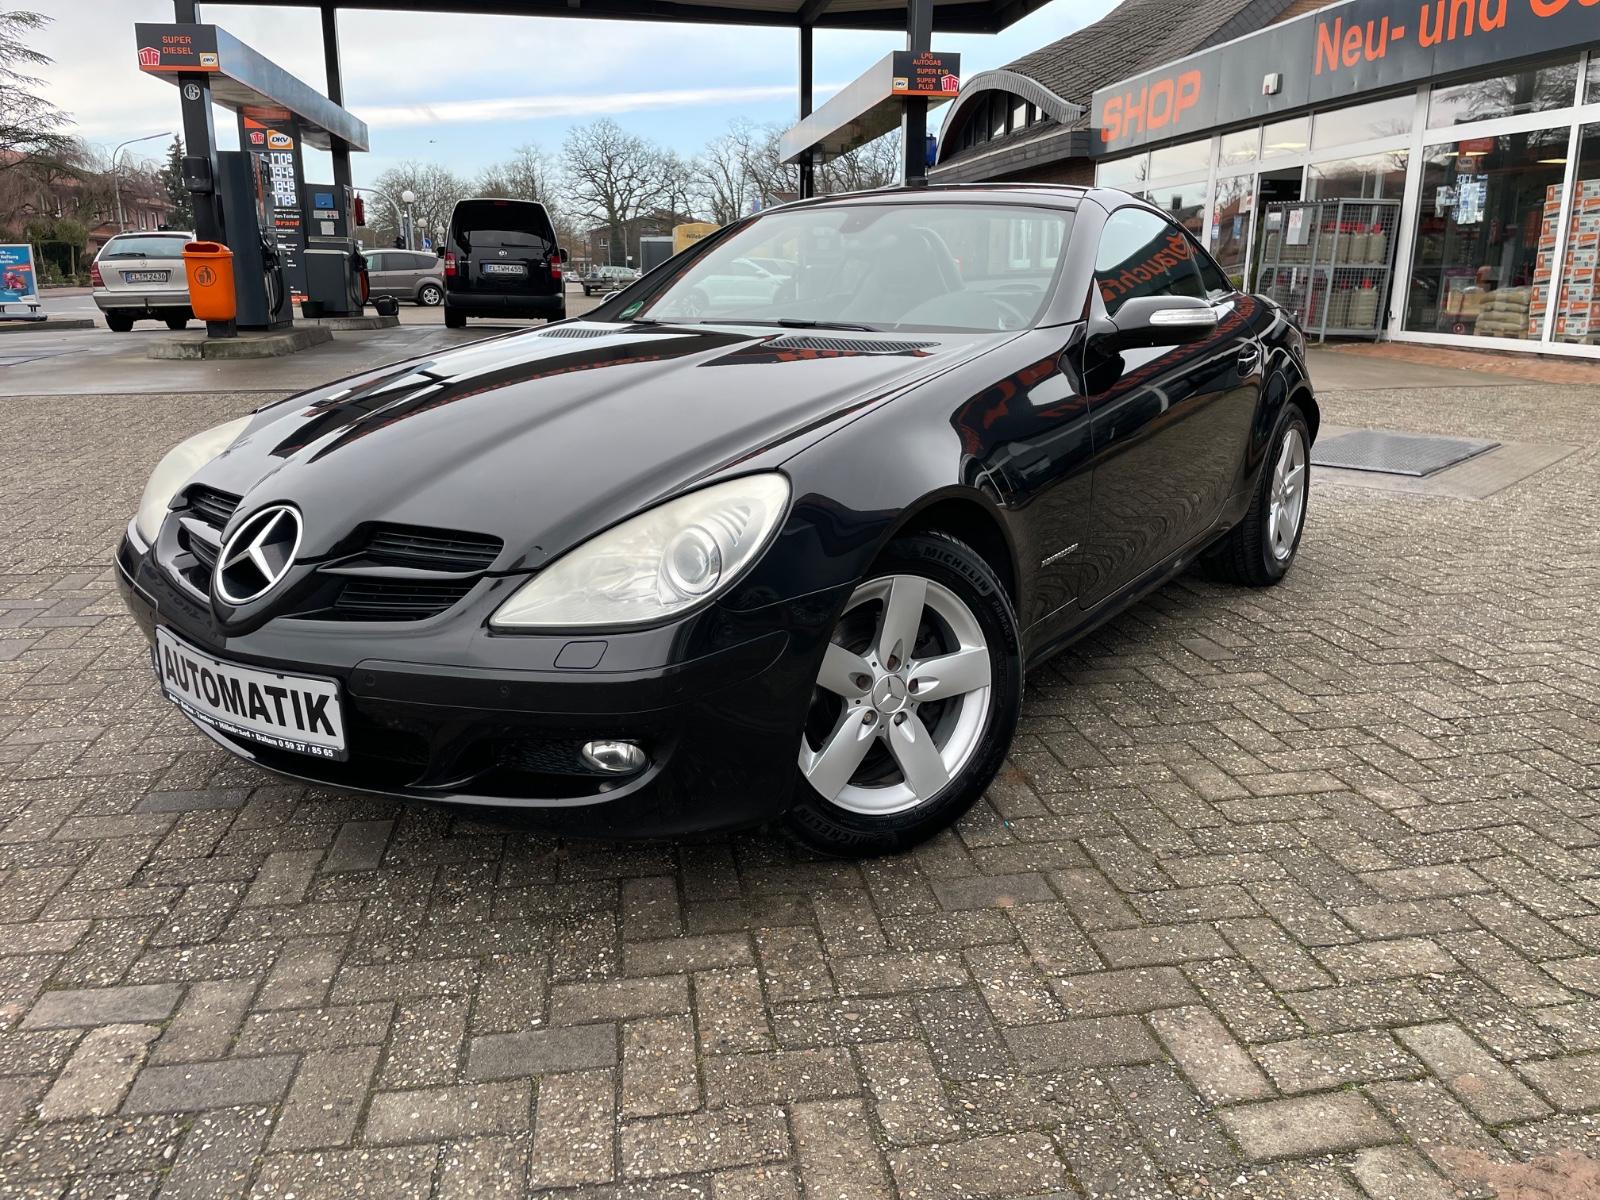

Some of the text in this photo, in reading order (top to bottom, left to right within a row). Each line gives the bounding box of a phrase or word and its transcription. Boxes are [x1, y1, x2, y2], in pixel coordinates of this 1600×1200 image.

[162, 35, 192, 44] SUPER
[1314, 16, 1405, 75] Neu-
[138, 47, 160, 66] UTA
[162, 46, 193, 55] DIESEL
[941, 74, 960, 92] UTA
[1101, 69, 1201, 144] SHOP
[922, 546, 991, 592] MICHELIN
[164, 644, 337, 737] AUTOMATIK
[285, 741, 294, 750] 59
[296, 743, 305, 752] 37
[312, 746, 322, 755] 85
[323, 748, 333, 757] 65
